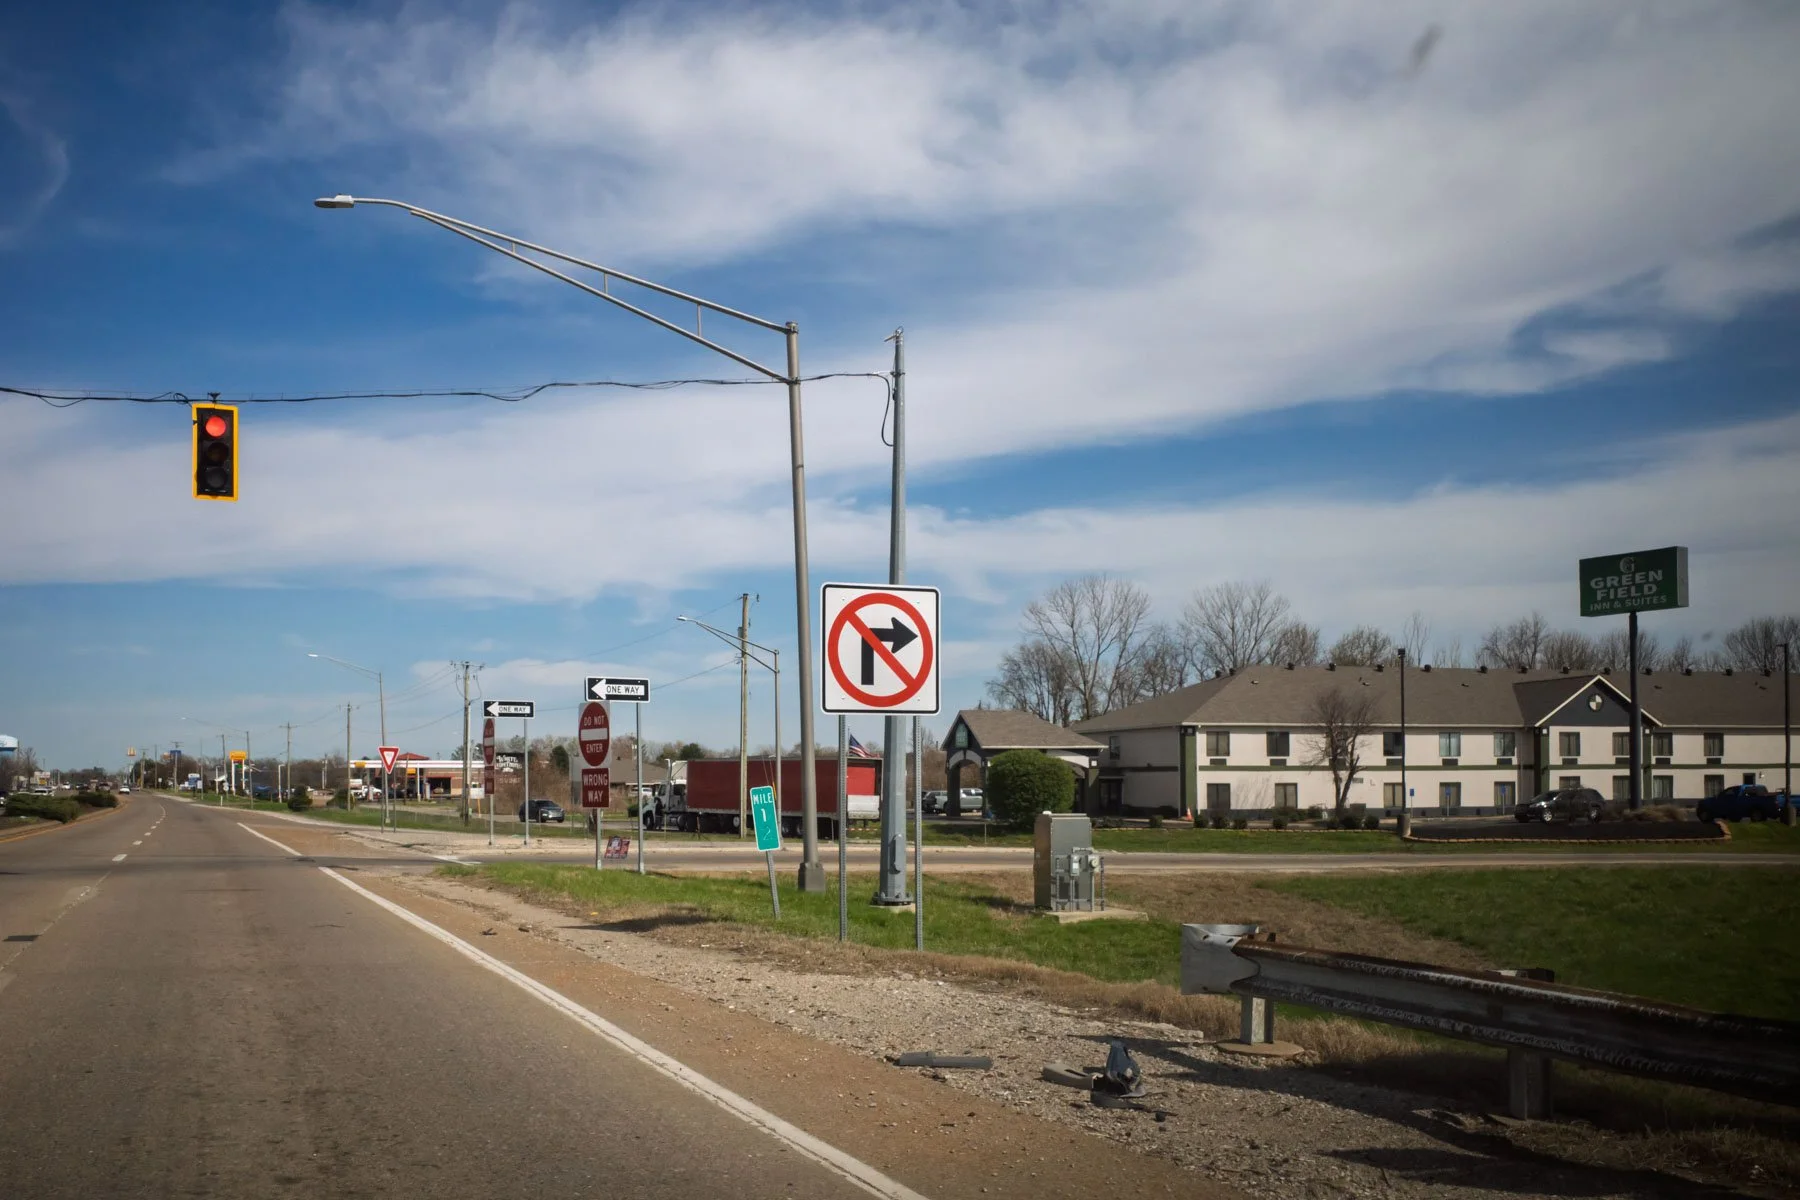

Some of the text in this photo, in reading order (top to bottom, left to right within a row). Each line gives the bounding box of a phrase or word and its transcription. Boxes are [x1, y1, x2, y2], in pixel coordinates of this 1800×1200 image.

[1590, 570, 1663, 589] GREEN
[1596, 584, 1658, 601] FIELD
[1590, 602, 1610, 611] INN
[1625, 595, 1667, 607] SUITES
[606, 685, 640, 694] ONE WAY
[583, 715, 605, 727] DO NOT
[586, 744, 603, 753] ENTER
[583, 774, 608, 786] WRONG
[587, 791, 604, 803] WAY
[753, 792, 773, 805] MILE
[760, 808, 767, 823] 1
